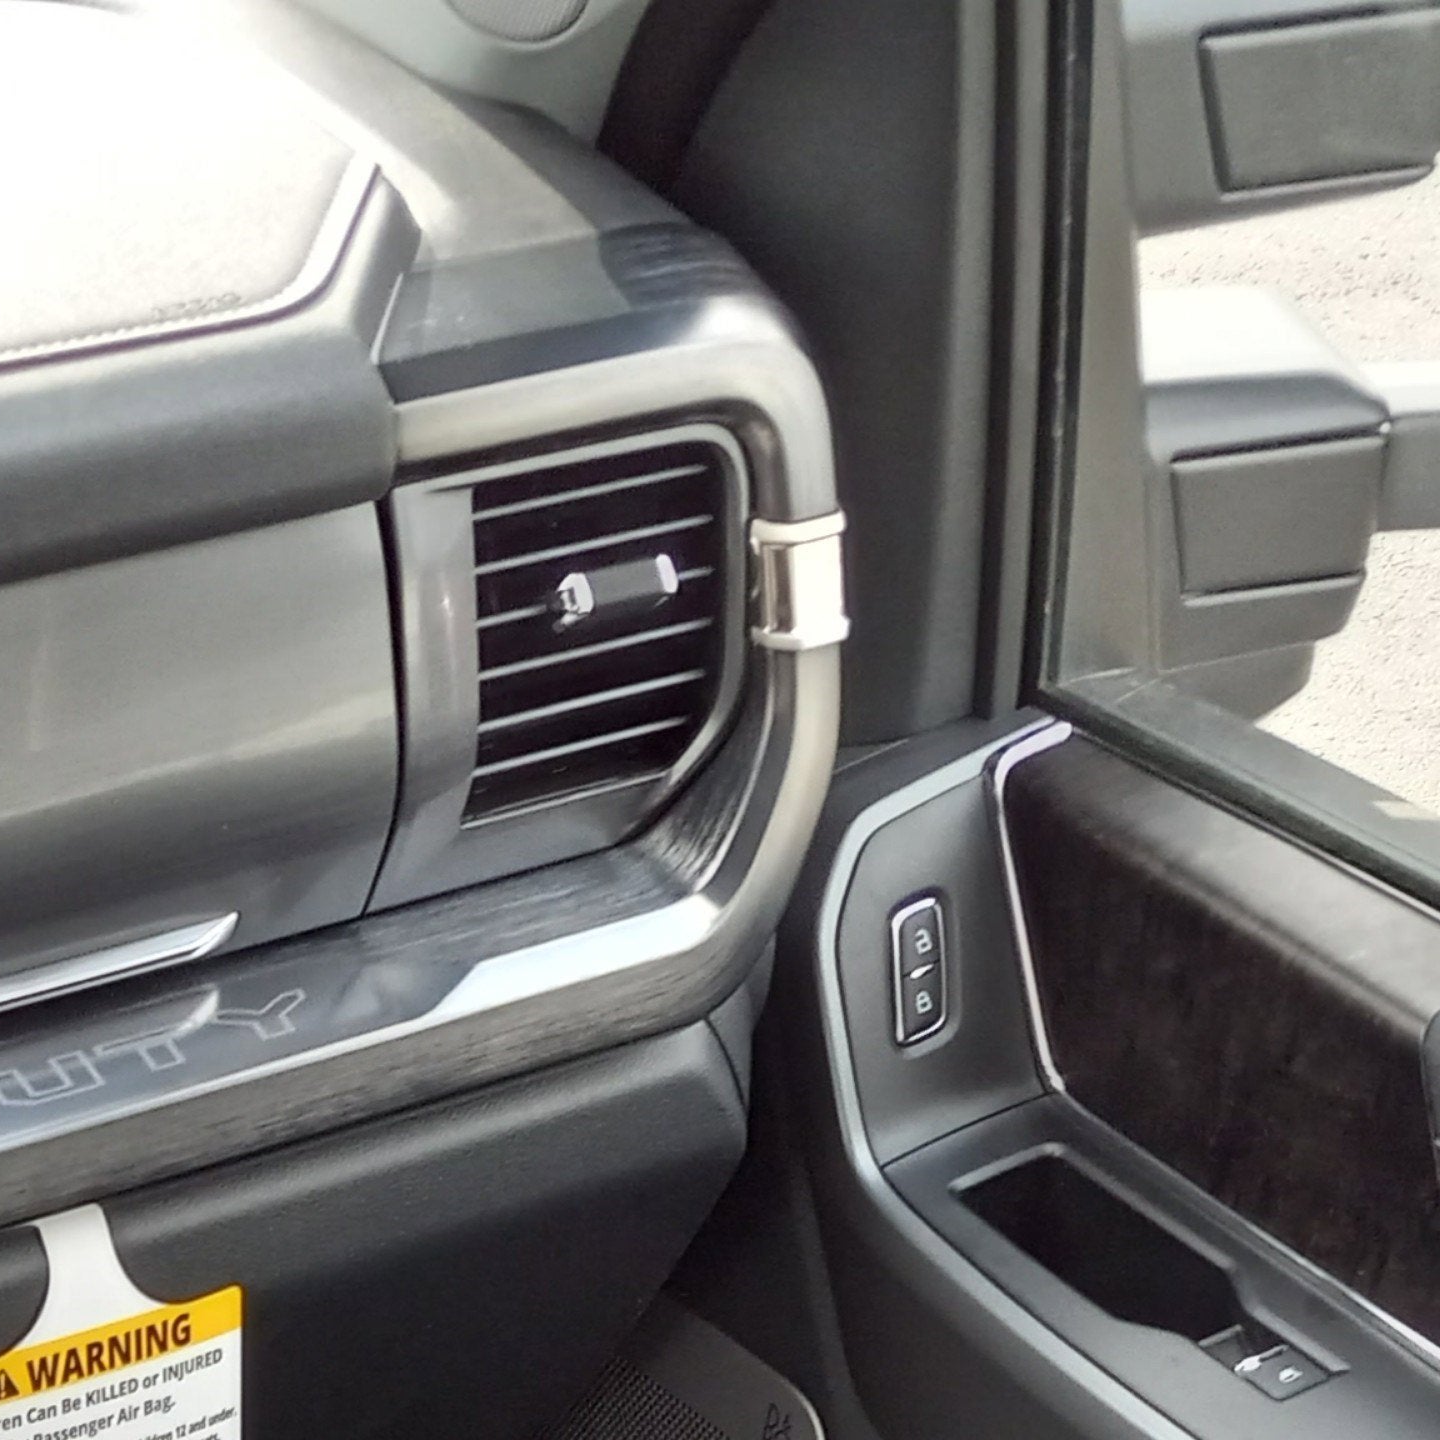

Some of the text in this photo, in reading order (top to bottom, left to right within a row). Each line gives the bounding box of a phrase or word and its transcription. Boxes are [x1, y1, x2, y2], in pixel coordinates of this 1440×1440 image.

[26, 1313, 192, 1393] WARNING
[26, 1402, 58, 1425] Can
[62, 1397, 81, 1415] Be
[85, 1378, 139, 1409] KILLED
[142, 1375, 159, 1390] or
[162, 1348, 223, 1384] INJURED
[116, 1406, 139, 1425] Air
[143, 1394, 176, 1420] Bag.
[175, 1424, 187, 1439] 12
[188, 1417, 207, 1435] and
